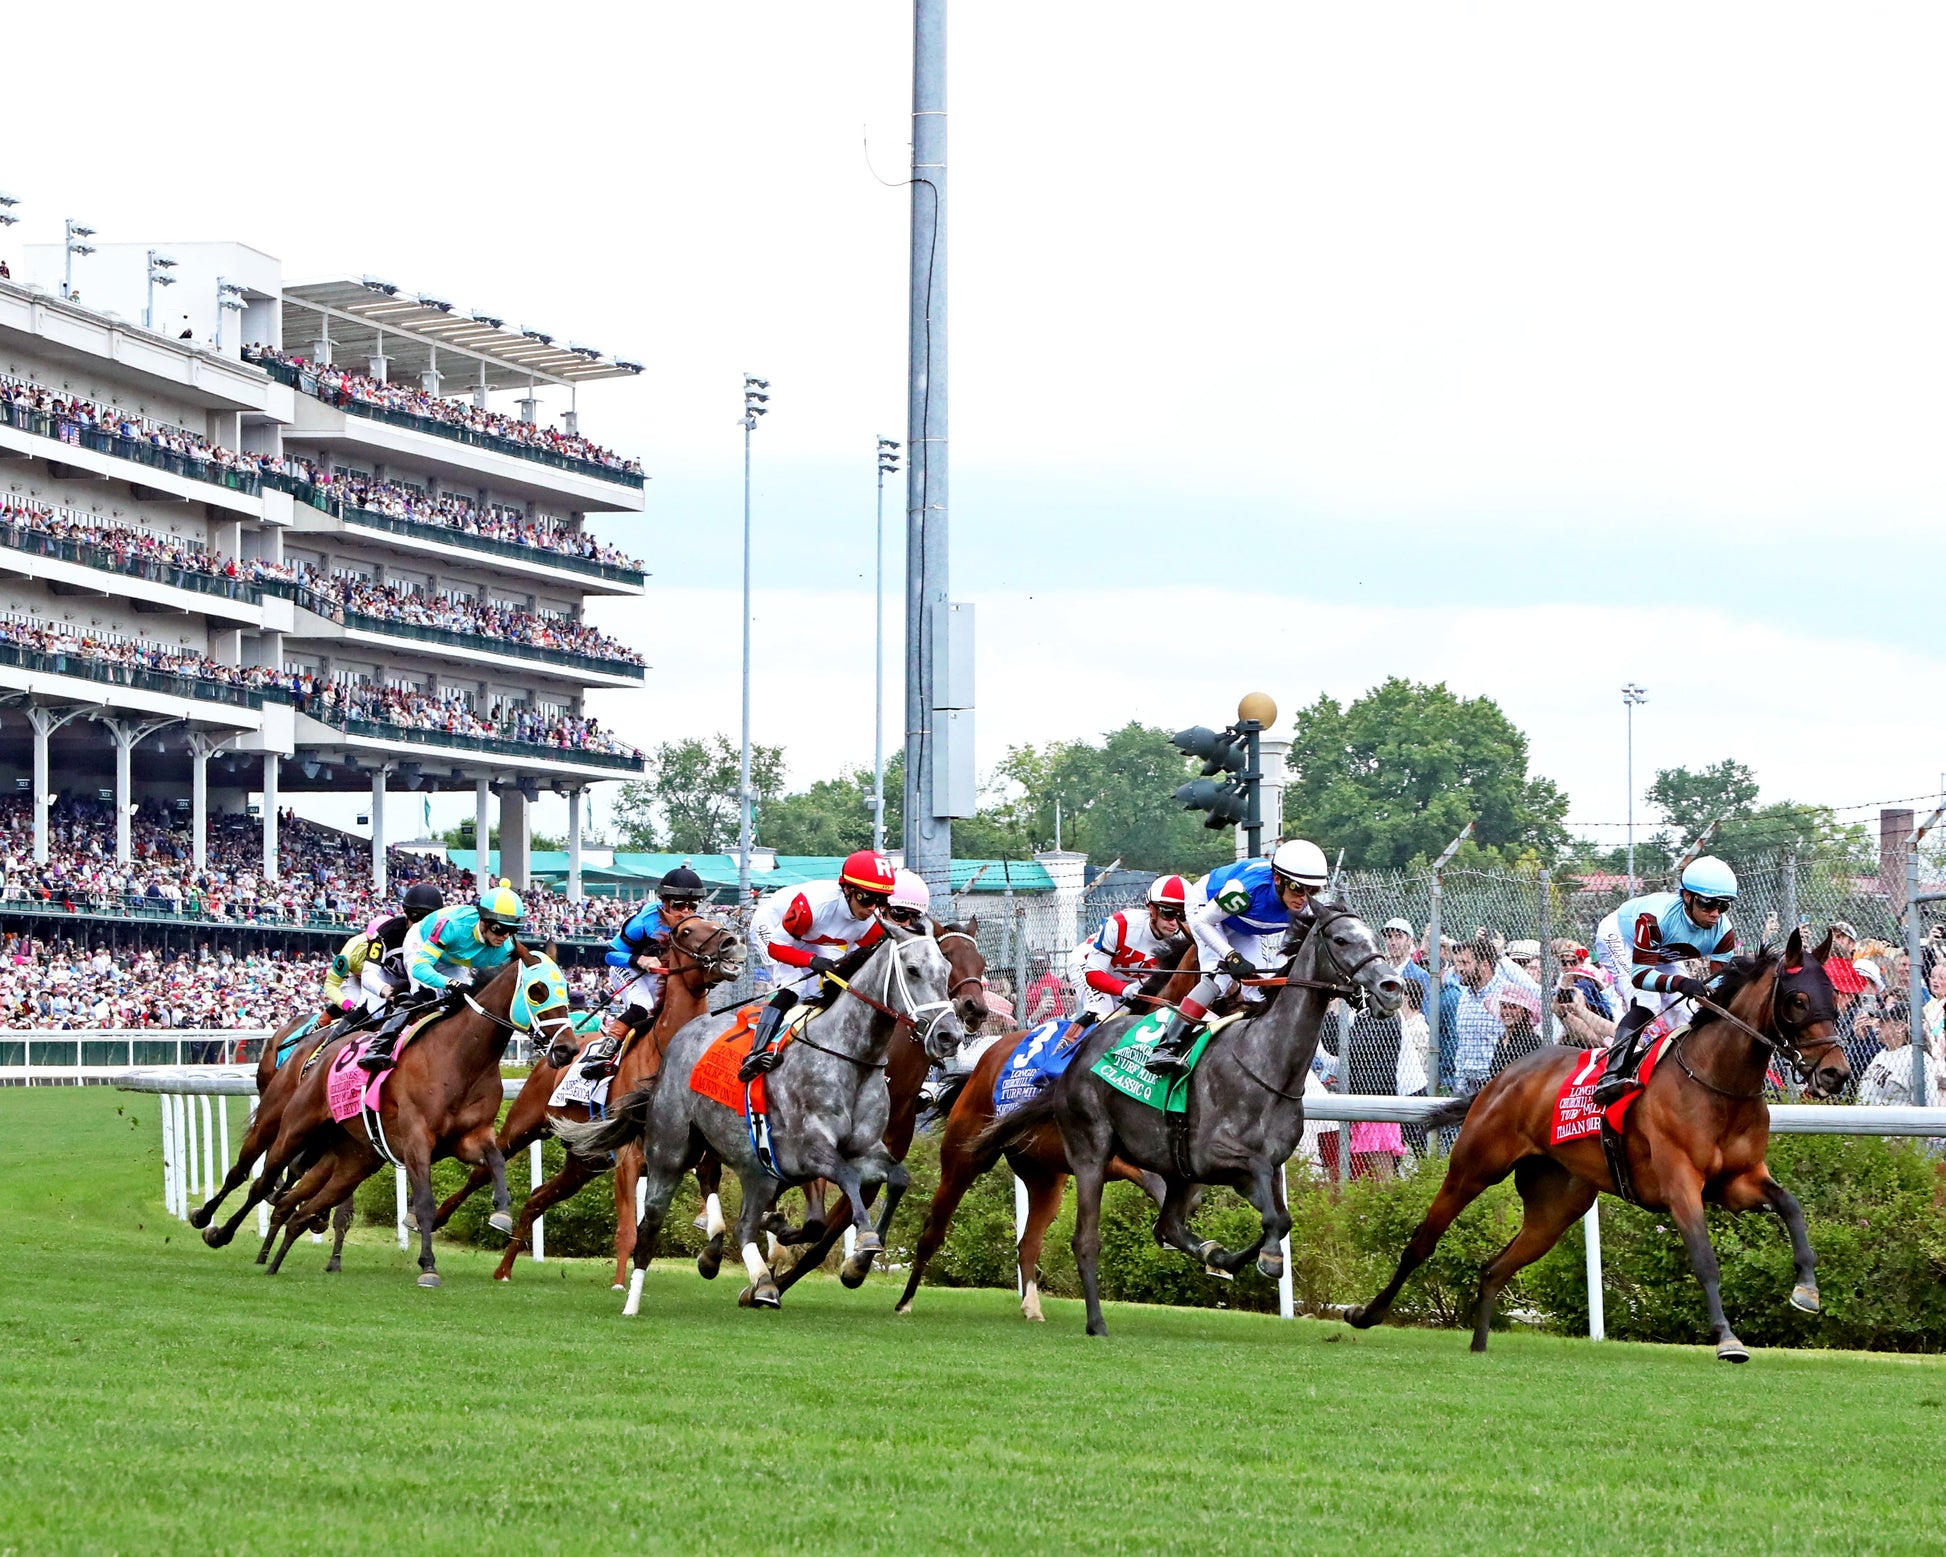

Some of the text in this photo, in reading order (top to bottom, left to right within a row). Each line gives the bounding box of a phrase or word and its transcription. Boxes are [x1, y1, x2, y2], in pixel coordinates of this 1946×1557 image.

[874, 858, 892, 878] R
[1224, 896, 1246, 911] 5
[369, 942, 382, 959] 6
[334, 959, 345, 973] 9
[1013, 1021, 1058, 1069] 3
[1113, 1055, 1140, 1075] TURF
[1100, 1065, 1152, 1101] CLASSIC Q
